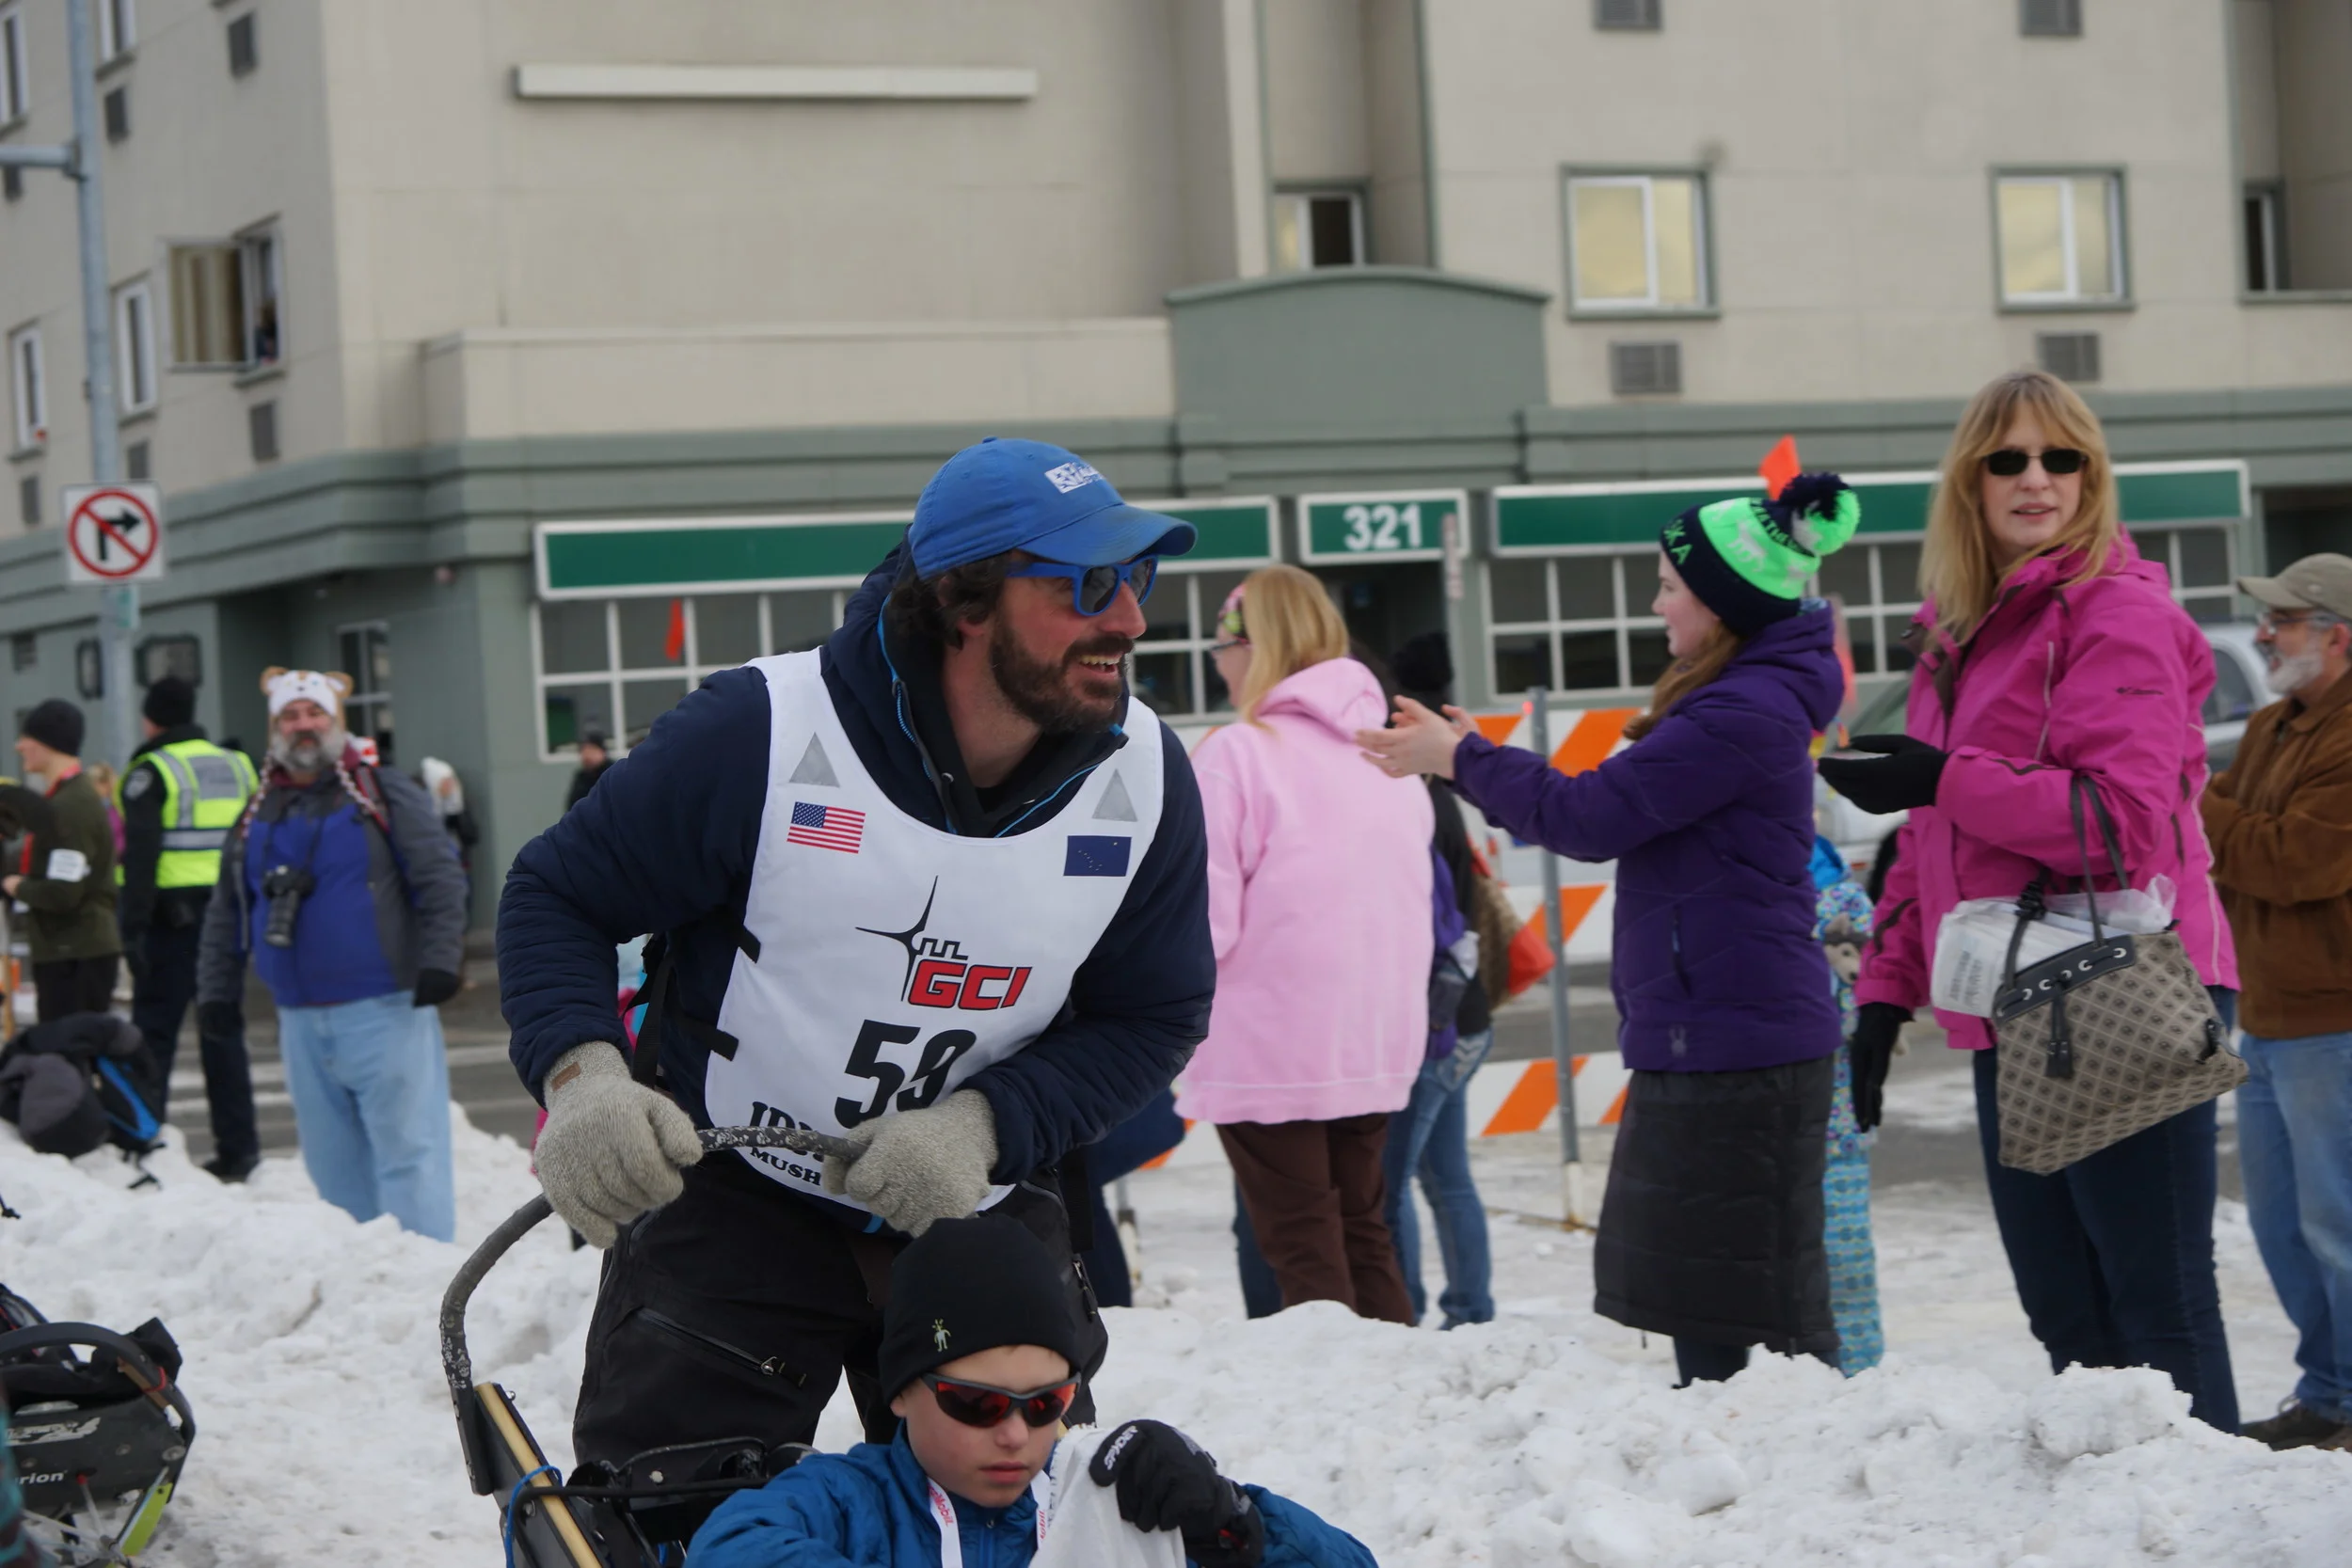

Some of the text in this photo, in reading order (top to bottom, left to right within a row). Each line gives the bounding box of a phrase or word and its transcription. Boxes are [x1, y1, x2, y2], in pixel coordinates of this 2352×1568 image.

[1343, 503, 1422, 550] 321
[908, 958, 1033, 1011] GCI
[834, 1019, 977, 1129] 59
[1104, 1425, 1138, 1470] SPYDER
[17, 1472, 65, 1485] rion
